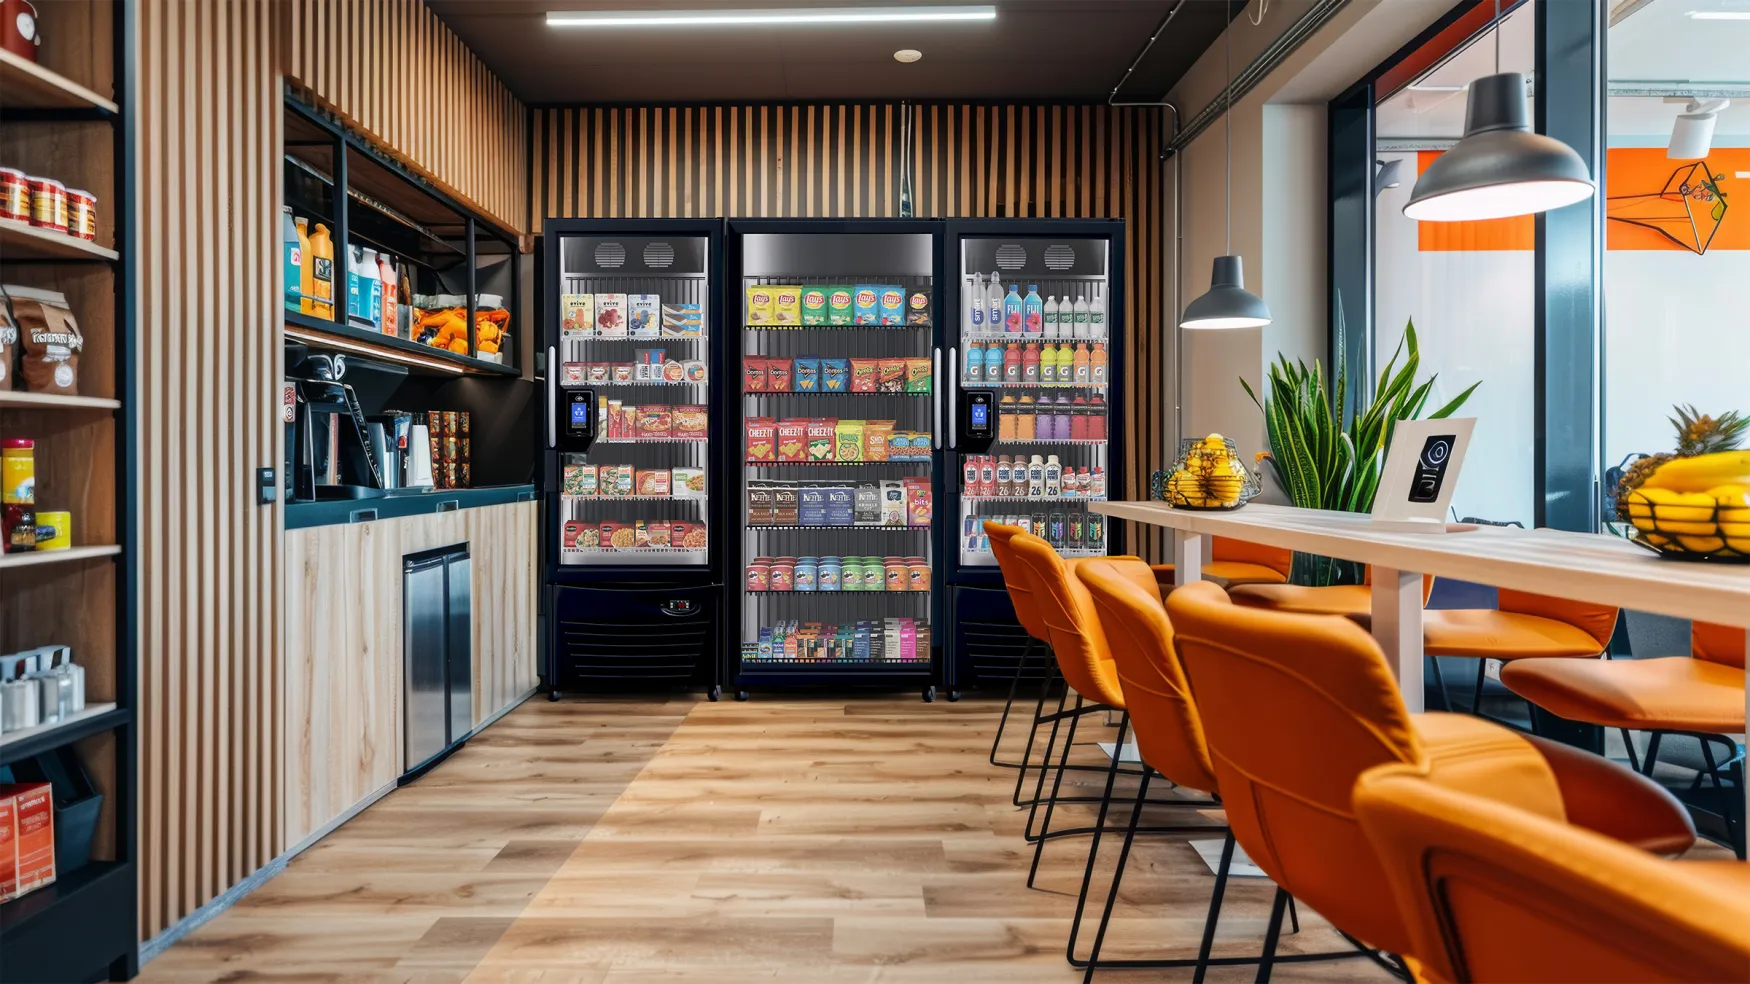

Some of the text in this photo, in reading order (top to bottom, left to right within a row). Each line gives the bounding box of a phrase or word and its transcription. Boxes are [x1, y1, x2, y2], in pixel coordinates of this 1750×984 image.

[1007, 304, 1020, 314] FIJI
[1026, 304, 1039, 314] FIJI
[970, 366, 978, 376] G
[989, 366, 997, 376] G
[1007, 366, 1016, 376] G
[1026, 366, 1035, 376] G
[1043, 366, 1052, 376] G
[1060, 366, 1069, 376] G
[1077, 366, 1086, 376] G
[1094, 366, 1103, 376] G
[999, 486, 1009, 496] 26
[1014, 486, 1025, 496] 26
[1031, 486, 1041, 496] 26
[1048, 486, 1058, 496] 26
